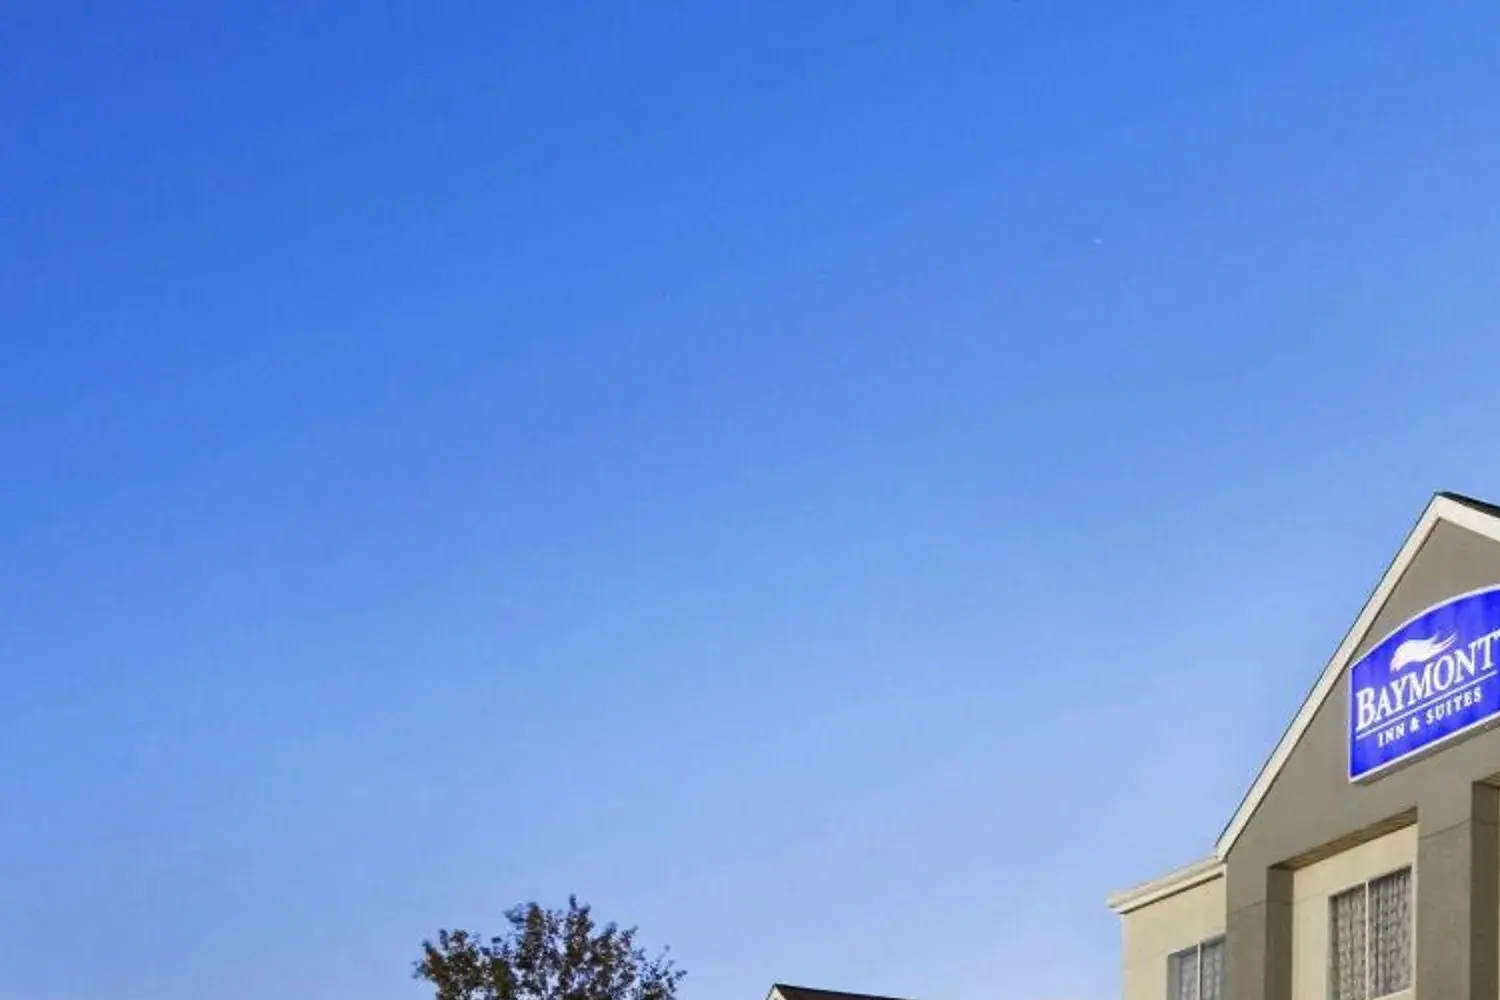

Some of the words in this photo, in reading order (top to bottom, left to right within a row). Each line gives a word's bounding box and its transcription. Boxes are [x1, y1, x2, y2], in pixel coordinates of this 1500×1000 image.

[1356, 636, 1495, 731] BAYMONT
[1377, 723, 1405, 747] INN
[1410, 717, 1420, 732] &
[1426, 687, 1482, 724] SUITES
